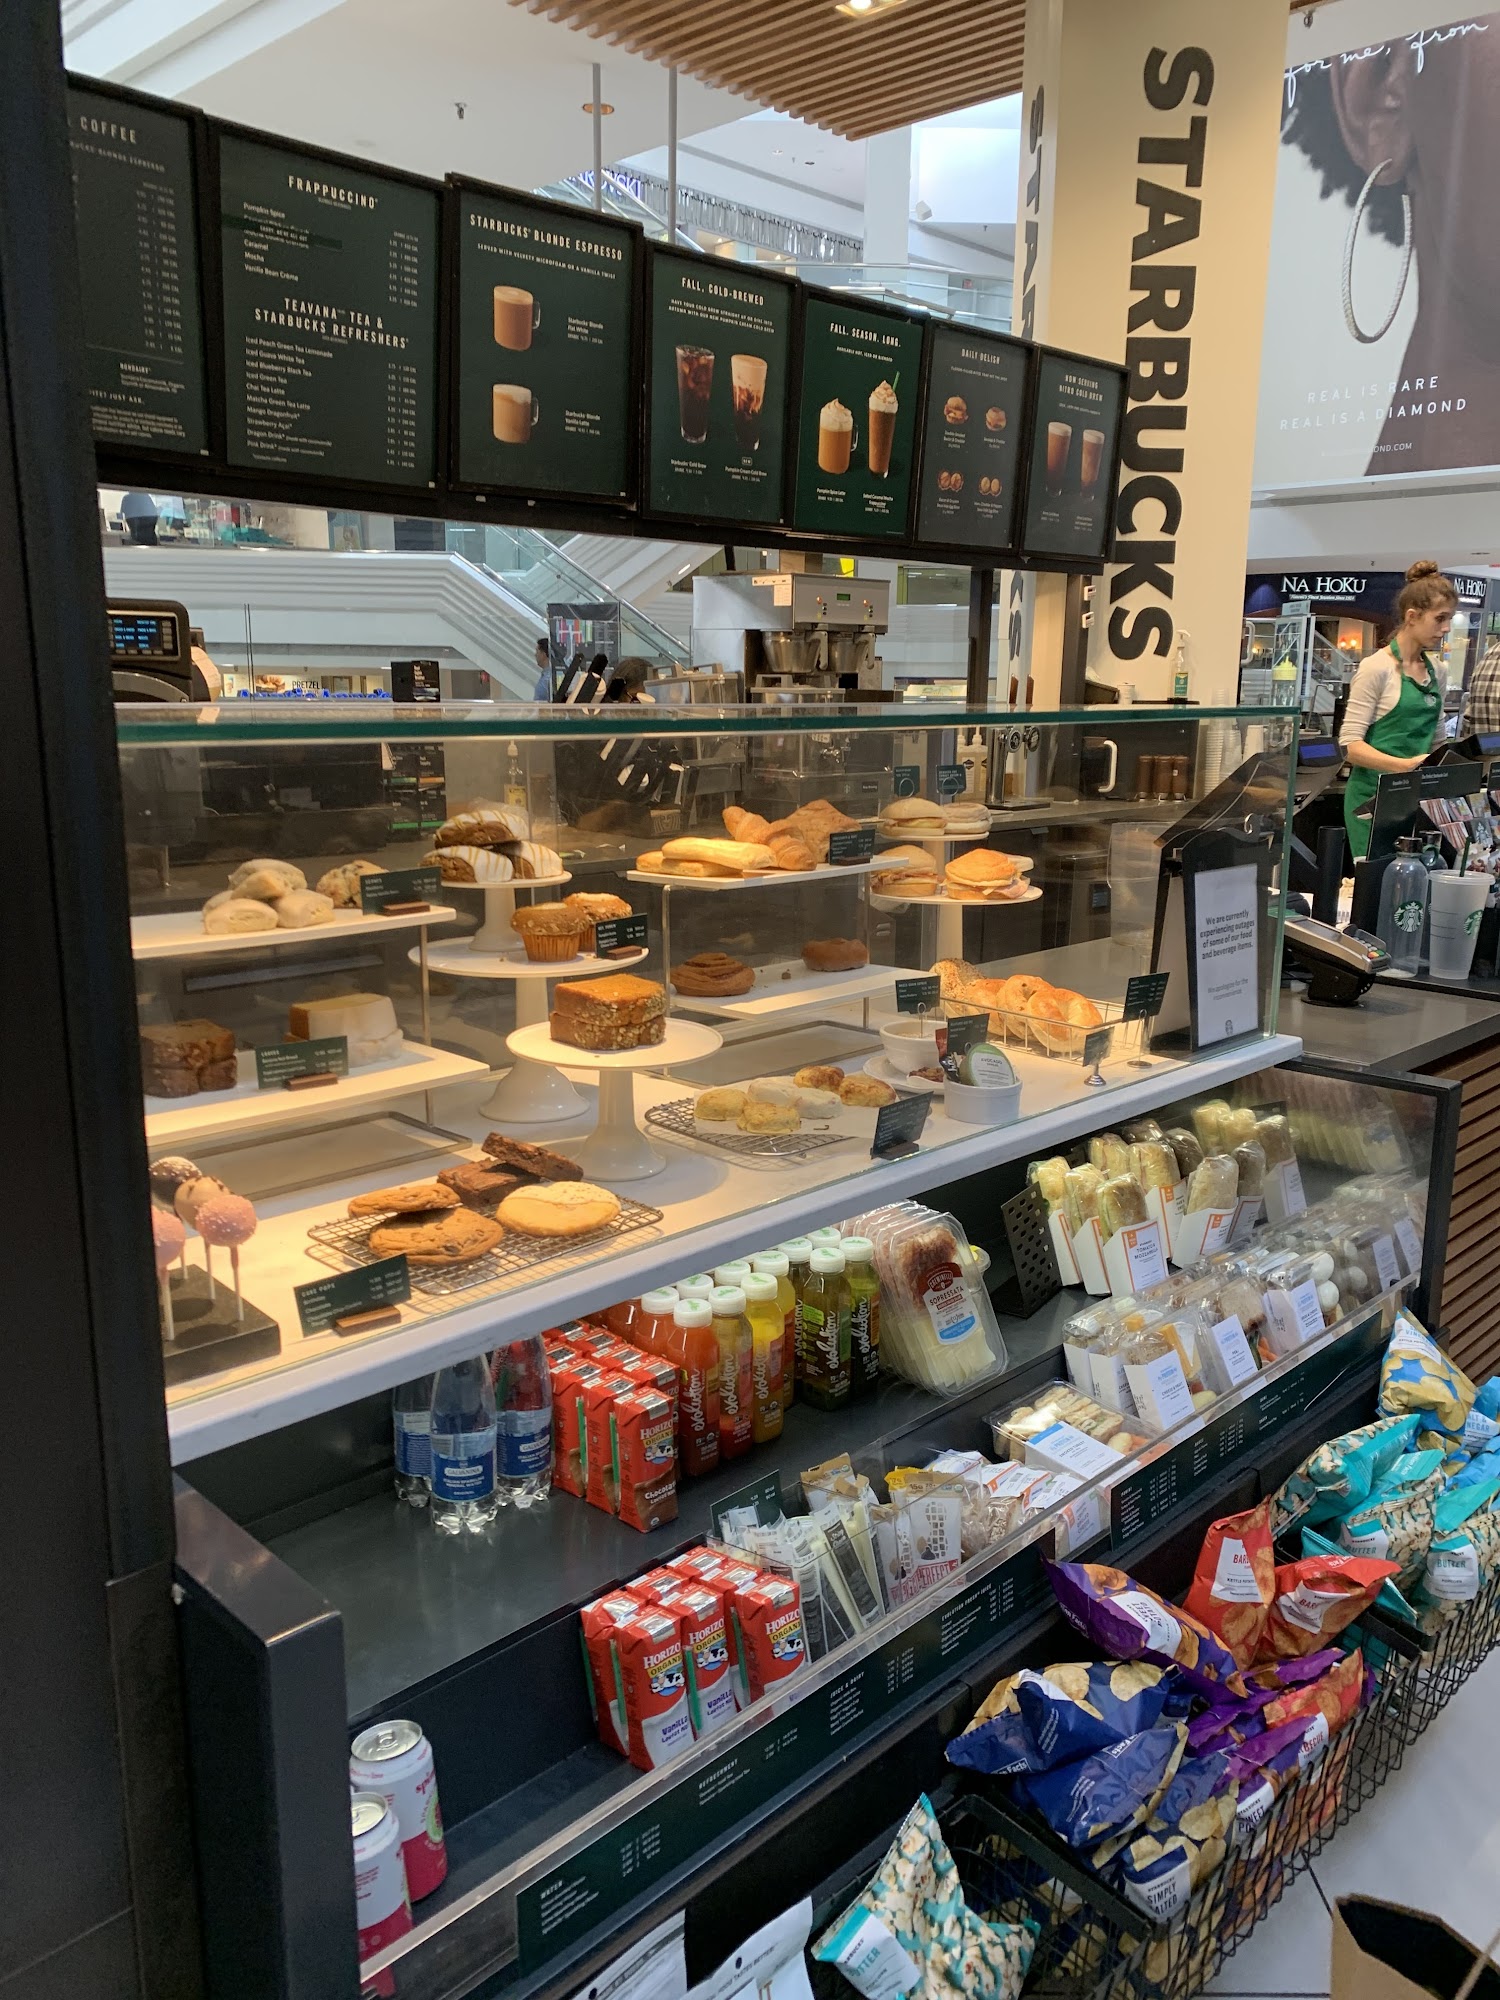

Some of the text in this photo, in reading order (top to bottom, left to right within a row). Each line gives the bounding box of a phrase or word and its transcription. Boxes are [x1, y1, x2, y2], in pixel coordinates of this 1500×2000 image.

[1284, 23, 1489, 109] for me, from
[80, 116, 137, 144] COFFEE
[243, 239, 269, 251] Caramel
[534, 229, 571, 249] BLONDE
[575, 239, 622, 261] ESPRESSO
[244, 252, 265, 263] Mocha
[499, 247, 513, 256] WITH
[536, 256, 567, 269] MICROFOAM
[580, 266, 600, 277] VANILLA
[244, 264, 264, 275] Vanilla
[265, 268, 280, 278] Bean
[708, 283, 764, 306] COLD-BREWED
[255, 307, 326, 334] STARBUCKS
[350, 311, 371, 328] TEA
[376, 316, 384, 329] &
[830, 322, 901, 348] FALL. SEASON. LONG.
[246, 336, 258, 345] Iced
[259, 337, 276, 348] Peach
[277, 340, 294, 351] Green
[305, 346, 333, 358] Lemonade
[246, 348, 258, 357] Iced
[259, 350, 277, 360] Guava
[278, 353, 294, 363] White
[961, 348, 1001, 365] DAILY DELISH
[1108, 45, 1215, 662] STARBUCKS
[246, 360, 258, 369] Iced
[259, 362, 286, 373] Blueberry
[287, 366, 304, 376] Black
[246, 371, 258, 380] Iced
[259, 374, 277, 384] Green
[246, 383, 260, 392] Chai
[271, 386, 285, 395] Latte
[1065, 374, 1098, 389] NOW SERVING
[1308, 375, 1440, 403] REAL IS RARE
[246, 394, 268, 404] Matcha
[268, 397, 285, 407] Green
[297, 401, 311, 410] Latte
[1059, 384, 1103, 402] NITRO COLD BREW
[246, 406, 267, 416] Mango
[1280, 398, 1467, 430] REAL IS A DIAMOND
[247, 417, 277, 428] Strawberry
[1280, 575, 1310, 593] NA
[1453, 577, 1465, 594] NA
[292, 680, 320, 690] PRETZEL
[1206, 909, 1249, 926] We are currently
[1200, 919, 1255, 939] experiencing outages
[1203, 931, 1252, 949] of some of our food
[1202, 942, 1253, 960] and beverage items.
[930, 1286, 964, 1306] SOPRESSATA
[640, 1420, 674, 1440] HORIZO
[1466, 1420, 1490, 1432] NEGAR
[645, 1430, 674, 1447] ORGANI
[644, 1479, 676, 1500] Chocolat
[765, 1608, 800, 1634] HORIZO
[689, 1620, 724, 1645] HORIZO
[696, 1632, 726, 1652] ORGANI
[643, 1642, 681, 1669] HORIZO
[650, 1655, 683, 1676] ORGANI
[1299, 1731, 1324, 1754] BECUE
[698, 1758, 738, 1790] REFRESHMENT
[1013, 1761, 1028, 1773] Facts
[1147, 1884, 1176, 1905] SIMPLY
